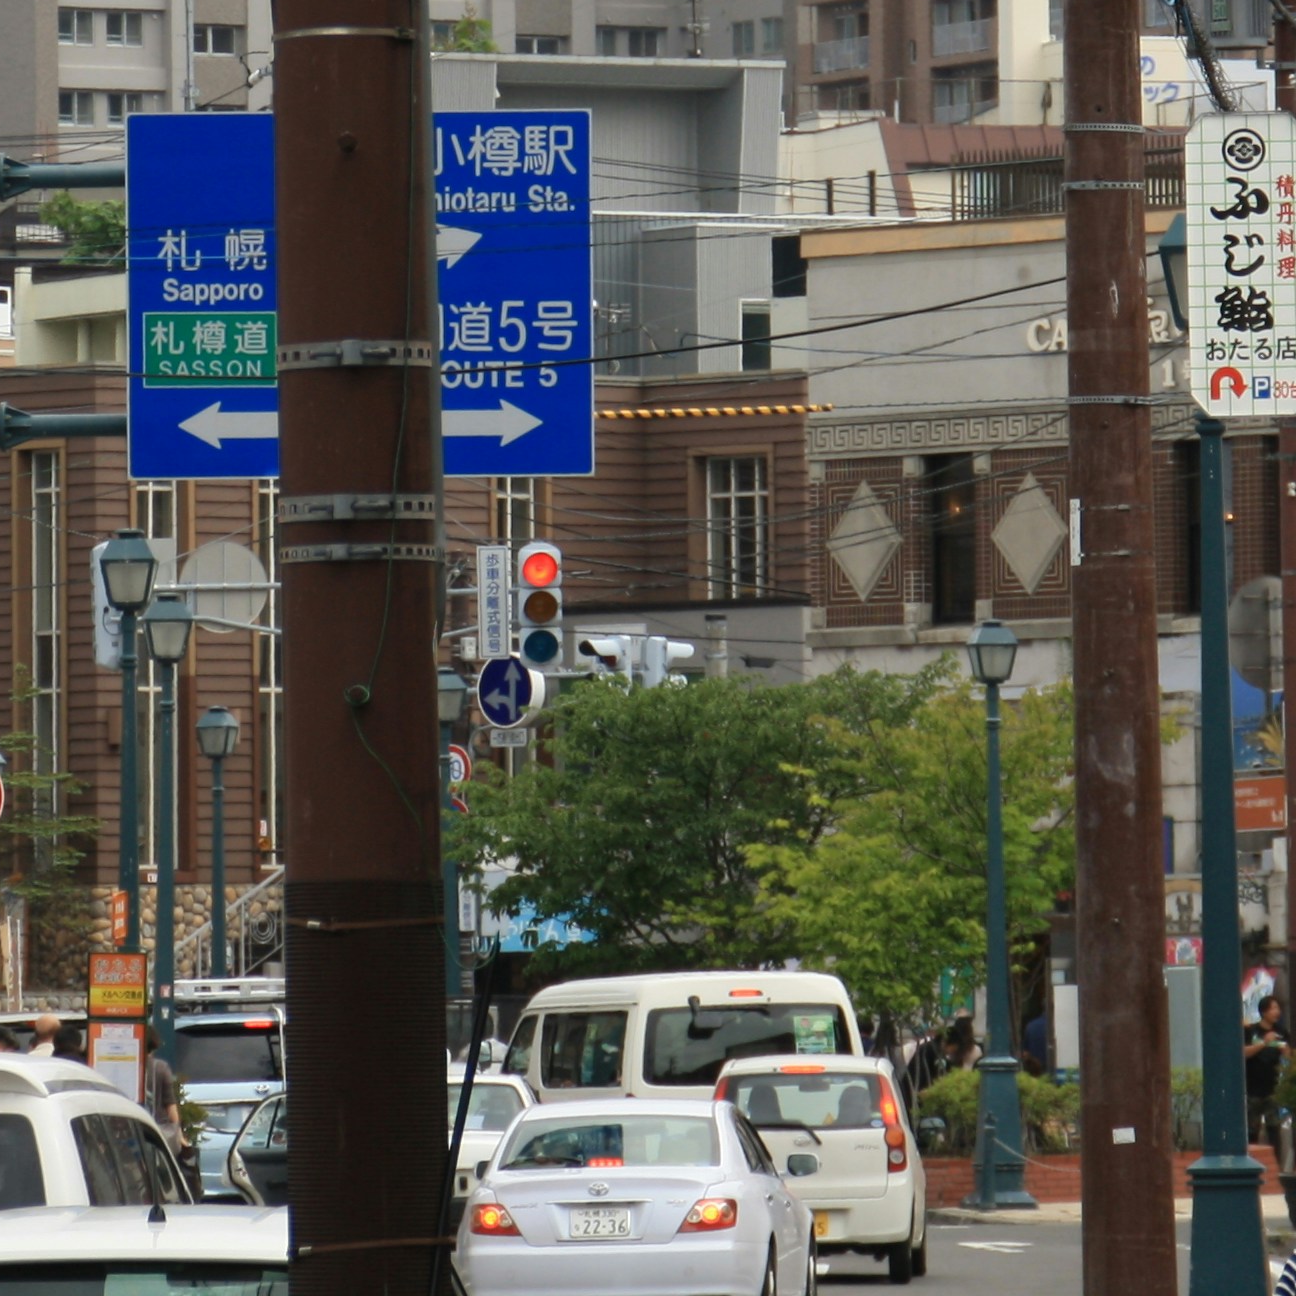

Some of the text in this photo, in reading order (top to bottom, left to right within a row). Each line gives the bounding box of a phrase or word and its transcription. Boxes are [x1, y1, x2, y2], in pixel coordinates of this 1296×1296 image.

[528, 184, 576, 213] Sta.
[158, 228, 268, 272] 札幌
[1210, 176, 1275, 333] ふじ鮨
[163, 278, 264, 305] Sapporo
[151, 320, 269, 356] 札樽道
[439, 300, 579, 353] 道5号
[159, 360, 263, 379] SASSON
[539, 360, 558, 388] 5
[583, 1219, 627, 1235] 22-36
